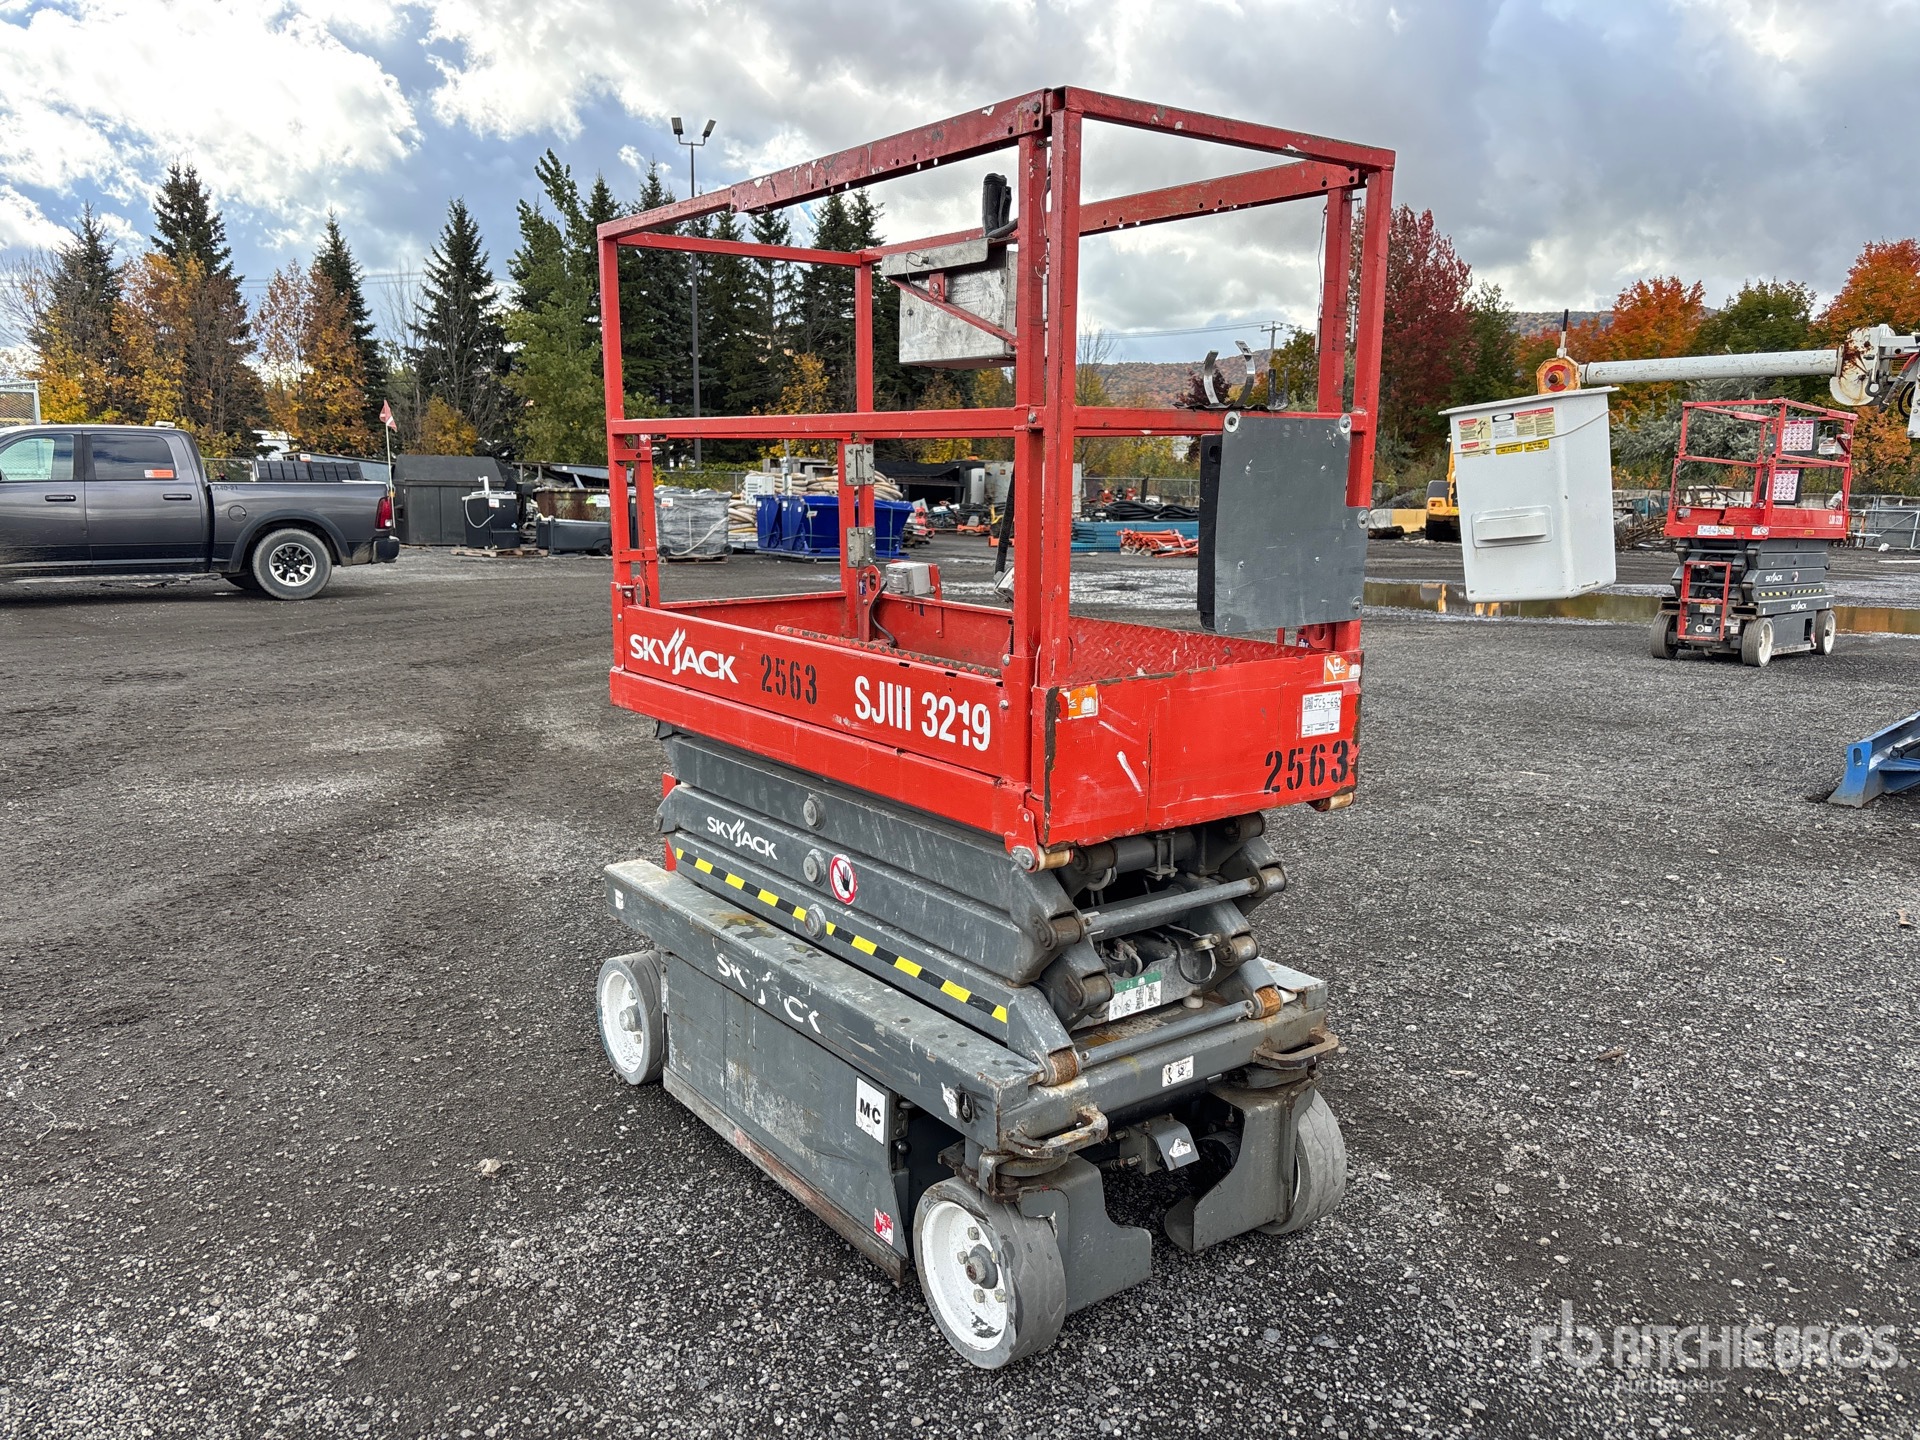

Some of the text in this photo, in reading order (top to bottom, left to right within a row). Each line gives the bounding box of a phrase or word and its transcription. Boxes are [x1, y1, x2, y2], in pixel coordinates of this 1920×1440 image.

[629, 627, 992, 752] SKYJACK 2563 SJIII 3219
[1263, 739, 1349, 795] 2563
[706, 816, 778, 860] SKYJACK
[859, 1097, 882, 1125] MC
